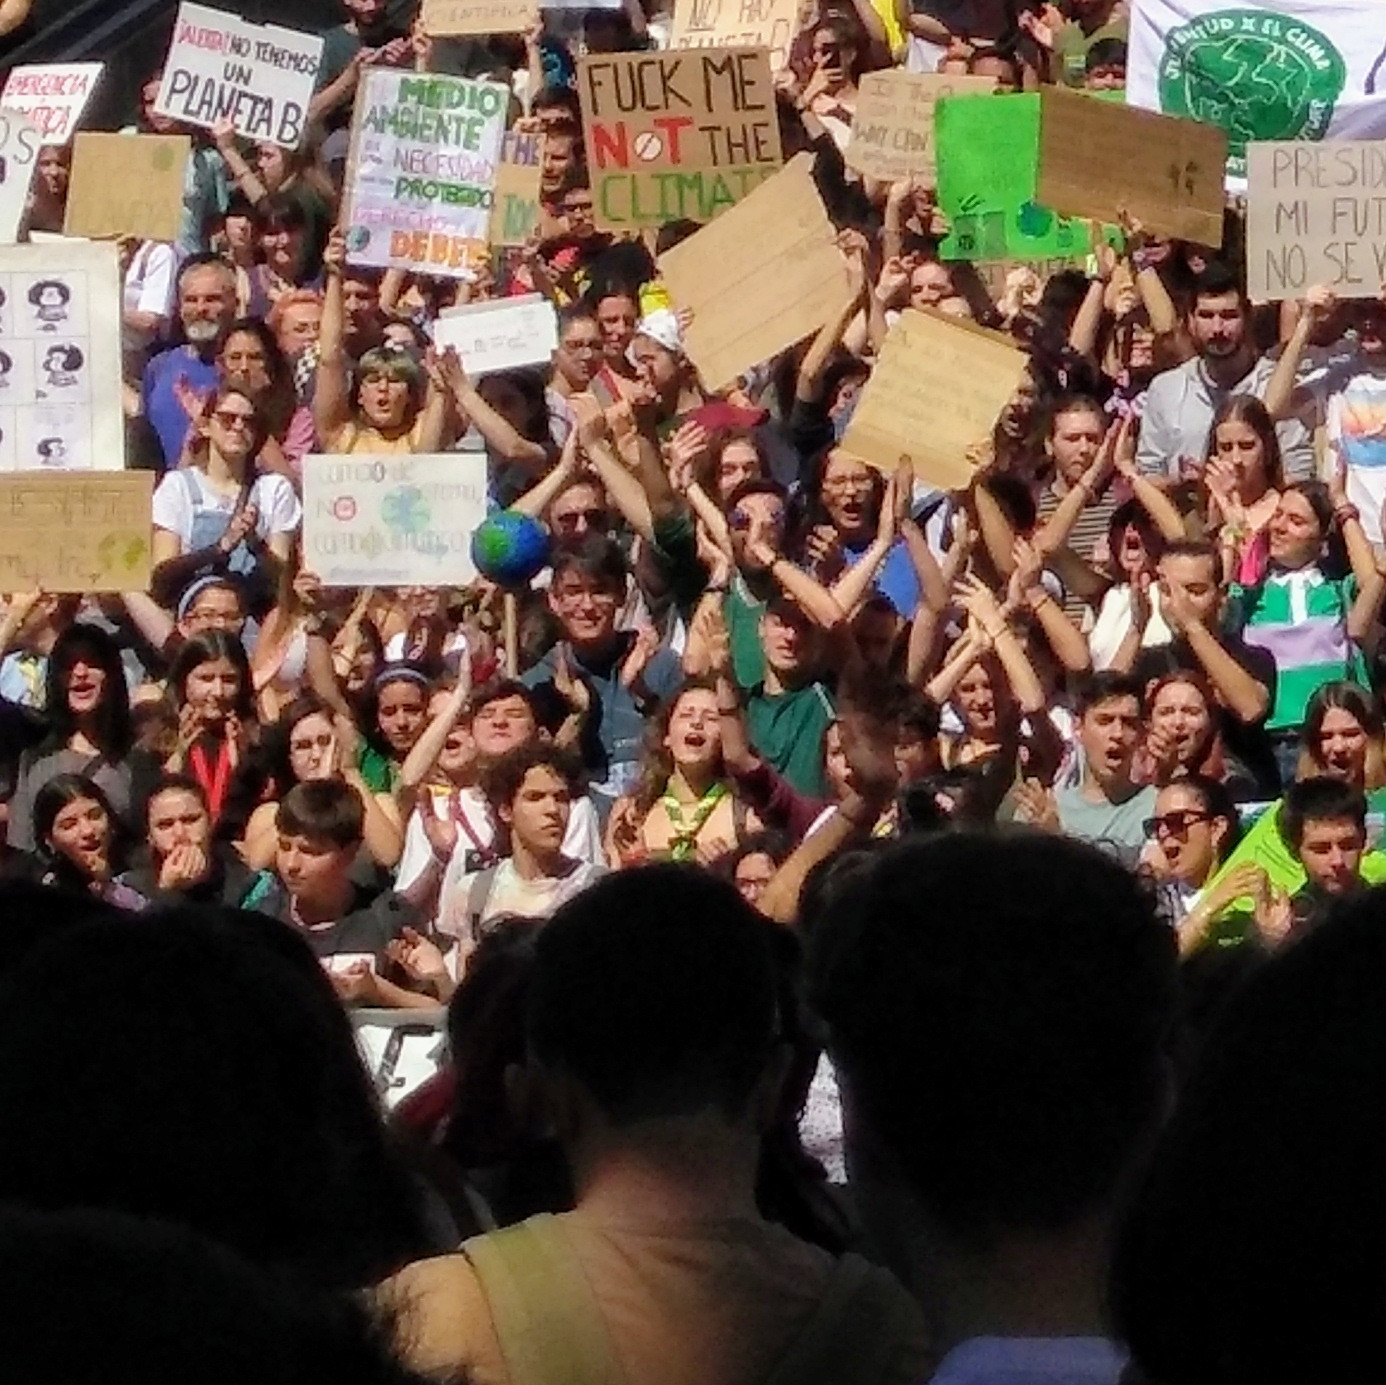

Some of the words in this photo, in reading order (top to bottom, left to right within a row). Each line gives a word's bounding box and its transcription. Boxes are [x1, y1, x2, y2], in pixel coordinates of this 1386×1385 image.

[229, 36, 251, 58] NO
[1240, 16, 1256, 32] X
[1284, 26, 1332, 70] CLIMA
[223, 61, 252, 86] UN
[587, 59, 692, 116] FUCK
[702, 53, 766, 112] ME
[164, 68, 274, 137] PLANETA
[276, 101, 303, 144] B
[399, 78, 500, 117] MEDIO
[698, 122, 770, 165] THE
[1275, 198, 1309, 236] MI
[1266, 243, 1306, 291] NO
[1323, 242, 1363, 285] SE
